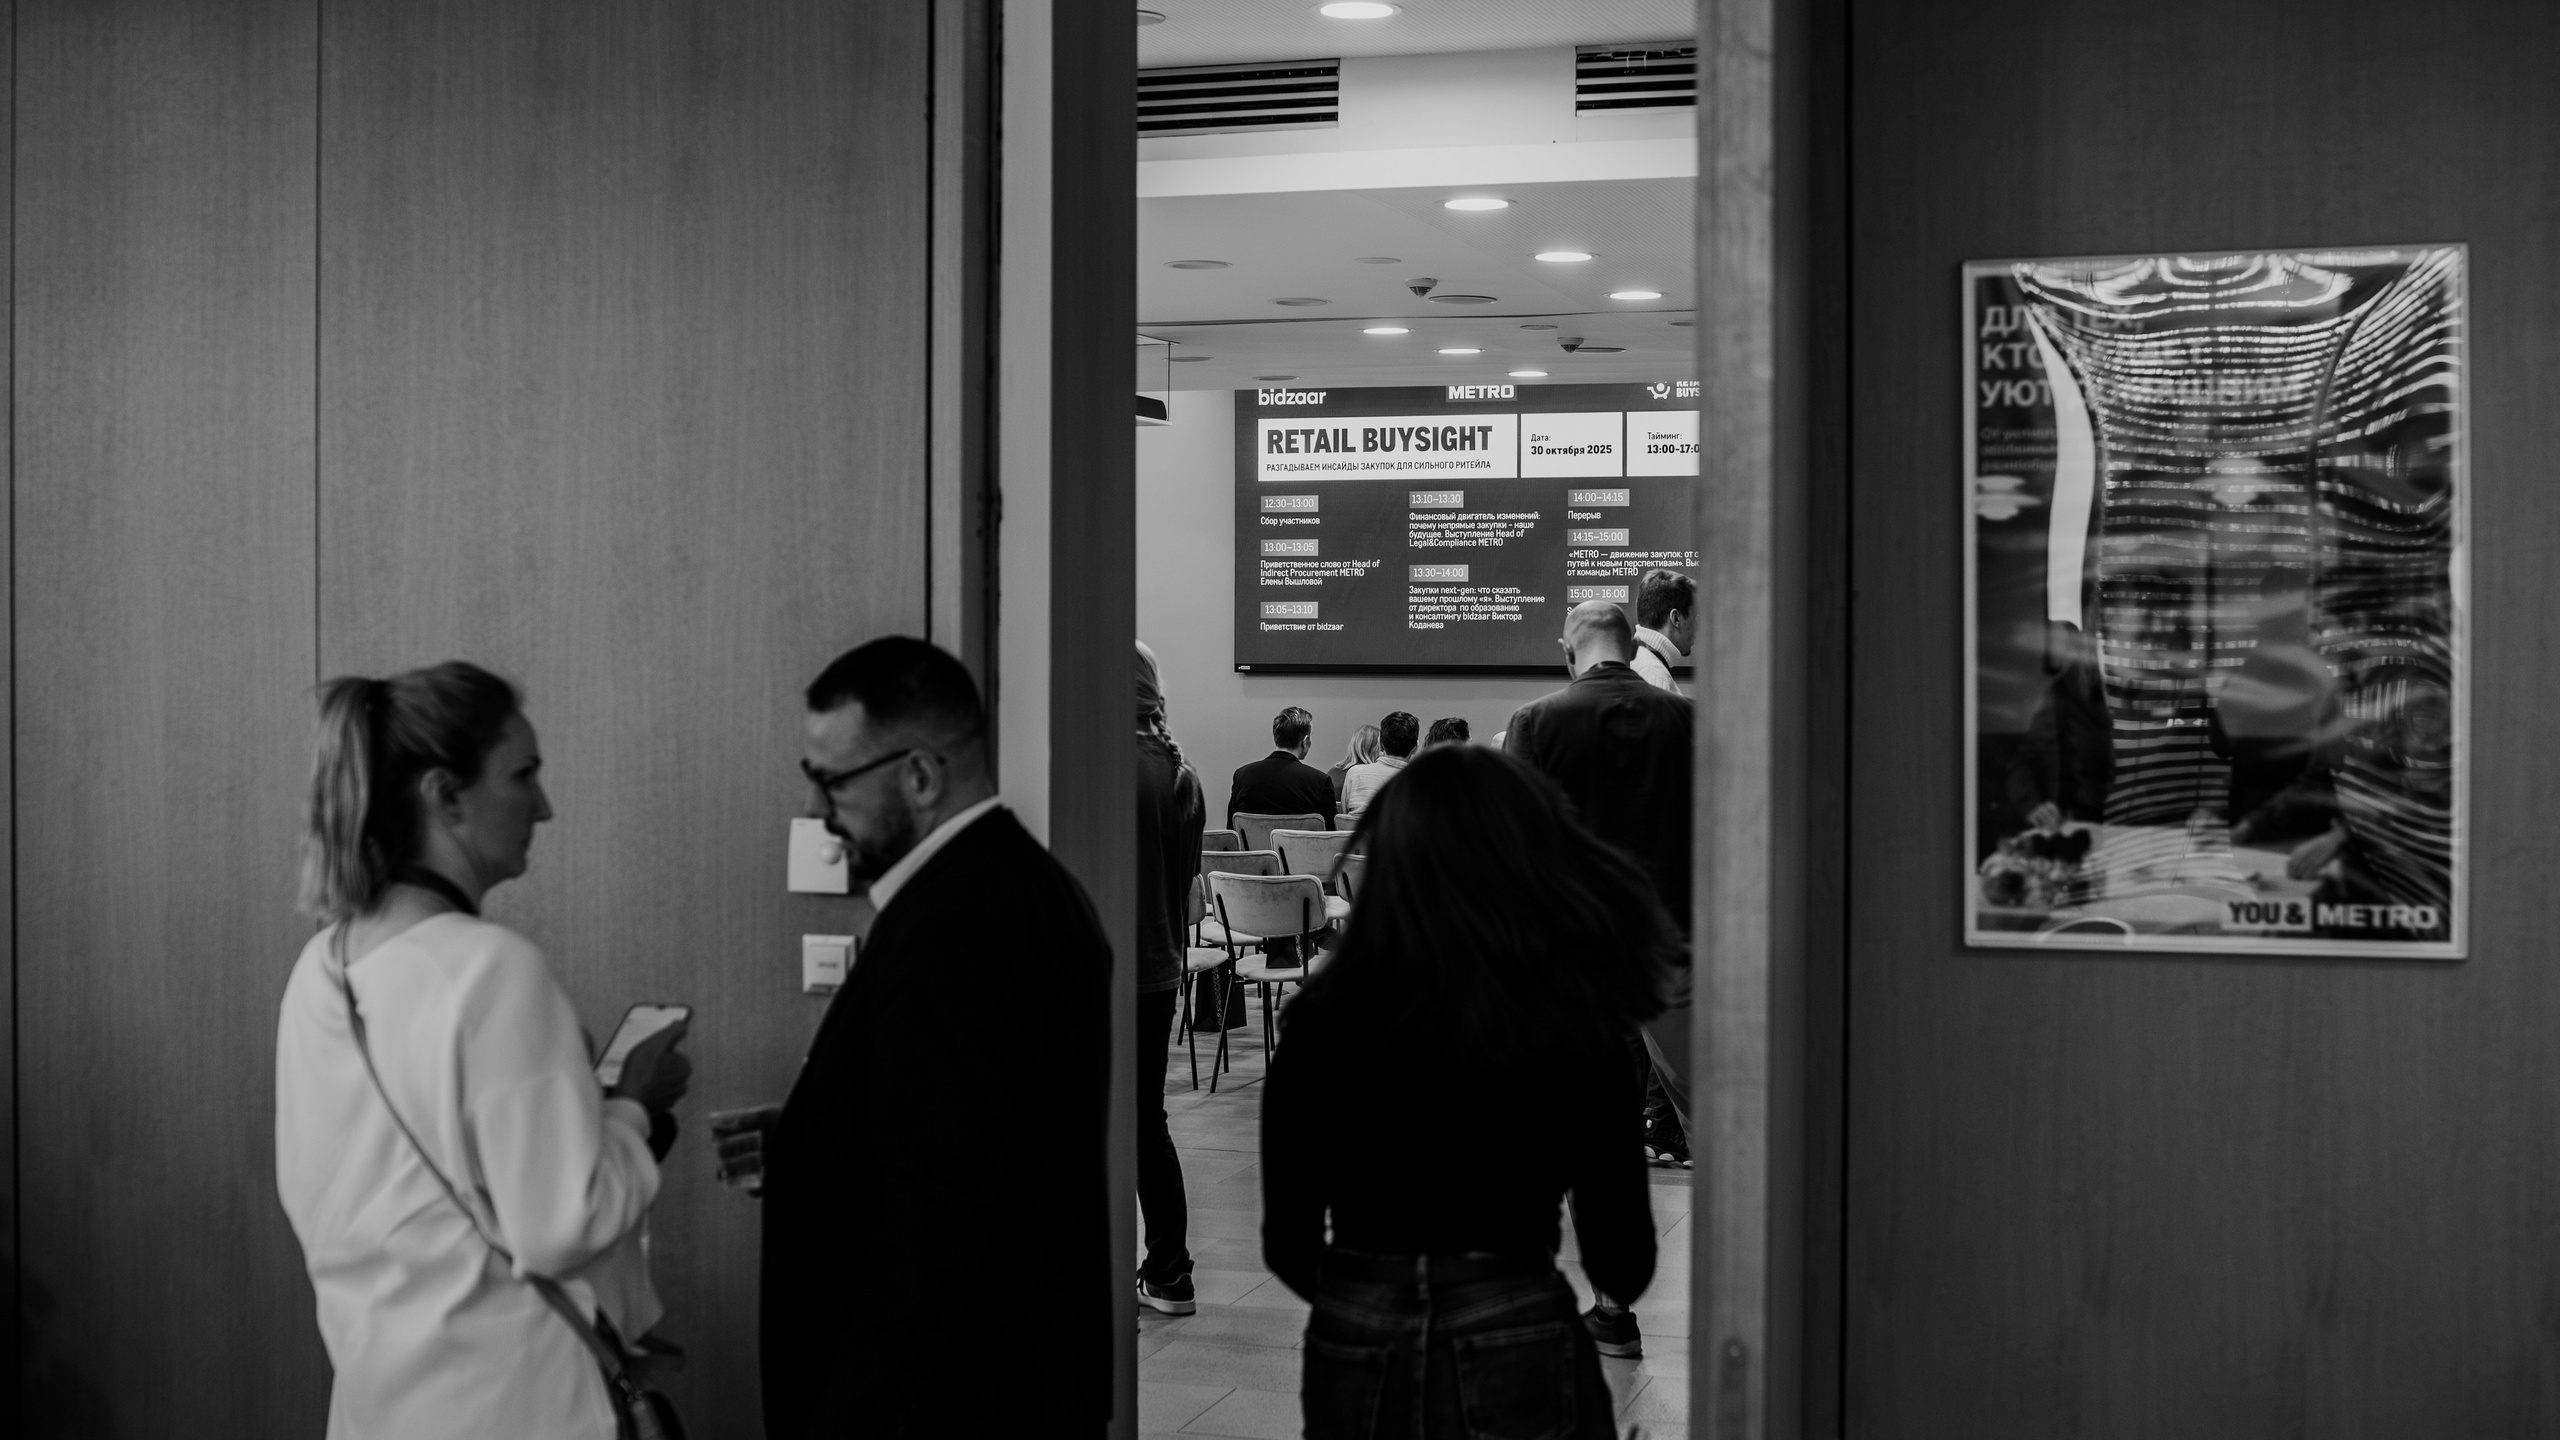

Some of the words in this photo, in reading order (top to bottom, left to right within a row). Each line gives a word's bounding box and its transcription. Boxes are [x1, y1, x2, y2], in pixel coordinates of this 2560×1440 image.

[1449, 385, 1514, 399] METRO
[1259, 388, 1326, 406] bidzaar
[1267, 427, 1355, 454] RETAIL
[1363, 426, 1492, 453] BUYSIGHT
[1531, 433, 1550, 442] Дата:
[1531, 447, 1543, 455] 30
[1546, 446, 1585, 457] октября
[1587, 445, 1612, 454] 2025
[1267, 463, 1321, 471] РАЗГАДЫВАЕМ
[1322, 462, 1359, 471] ИНСАЙДЫ
[1397, 462, 1412, 470] ДЛЯ
[1414, 461, 1453, 469] СИЛЬНОГО
[1455, 460, 1490, 468] РИТЕЙЛА
[1409, 512, 1456, 521] Финансовый
[1457, 513, 1495, 521] двигатель
[1497, 512, 1540, 520] изменений:
[1568, 511, 1601, 520] Перерыв
[1261, 517, 1278, 525] Сбор
[1280, 517, 1320, 526] участников
[1409, 522, 1436, 530] почему
[1438, 522, 1475, 530] непрямые
[1409, 530, 1443, 539] будущее.
[1445, 530, 1494, 538] Выступление
[1496, 530, 1515, 538] Head
[1516, 529, 1524, 538] of
[1409, 539, 1477, 548] Legal&Compliance
[1569, 550, 1599, 558] «METRO
[1610, 551, 1648, 559] движение
[1650, 551, 1682, 559] закупок:
[1261, 560, 1318, 569] Приветственное
[1353, 560, 1370, 568] Head
[1372, 560, 1380, 568] of
[1567, 560, 1589, 568] путей
[1624, 560, 1684, 568] перспективам».
[1261, 569, 1289, 577] Indirect
[1290, 569, 1338, 577] Procurement
[1613, 568, 1638, 576] METRO
[1285, 577, 1322, 585] Вышловой
[1409, 586, 1439, 595] Закупки
[1440, 587, 1476, 596] next-gen:
[1570, 589, 1593, 598] 15:00
[1602, 589, 1626, 598] 16:00
[1409, 596, 1438, 604] вашему
[1440, 596, 1478, 604] прошлому
[1495, 595, 1545, 603] Выступление
[1419, 605, 1456, 613] директора
[1471, 604, 1519, 612] образованию
[1415, 614, 1461, 622] консалтингу
[1492, 613, 1522, 621] Виктора
[1261, 623, 1306, 632] Приветствие
[1317, 623, 1344, 631] bidzaar
[1409, 622, 1444, 630] Коданева
[2230, 901, 2280, 924] YOU
[2285, 901, 2304, 924] &
[2317, 904, 2438, 929] METRO
